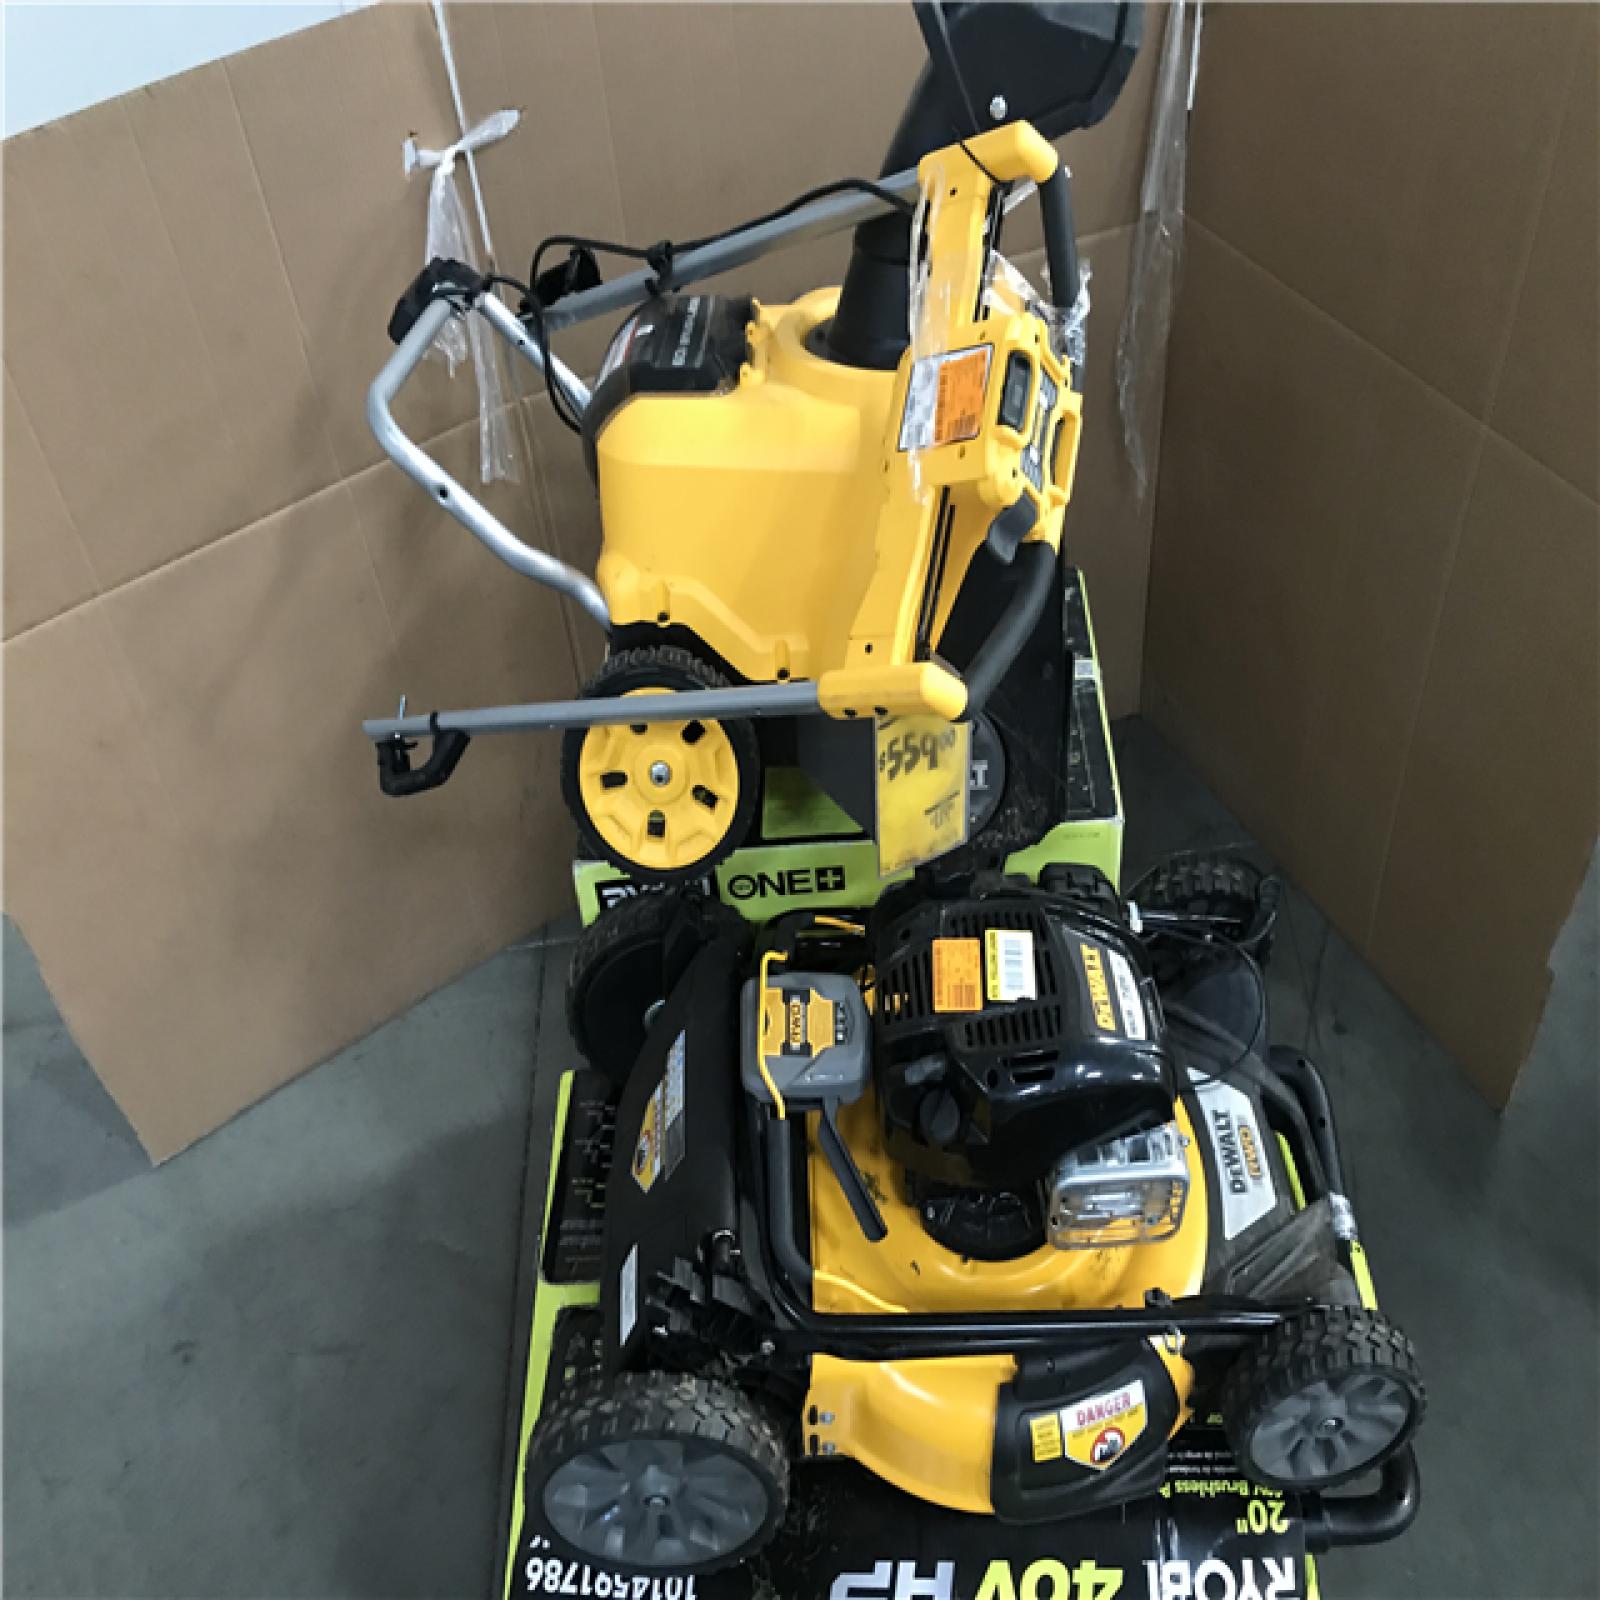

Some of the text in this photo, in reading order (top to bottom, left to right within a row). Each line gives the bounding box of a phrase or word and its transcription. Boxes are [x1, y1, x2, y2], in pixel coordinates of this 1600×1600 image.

[1211, 1109, 1248, 1195] DEWALT
[1075, 1391, 1131, 1426] DANGER
[1175, 1480, 1250, 1499] Brushless
[973, 1558, 1124, 1600] 40V
[1141, 1556, 1298, 1600] RYOBI
